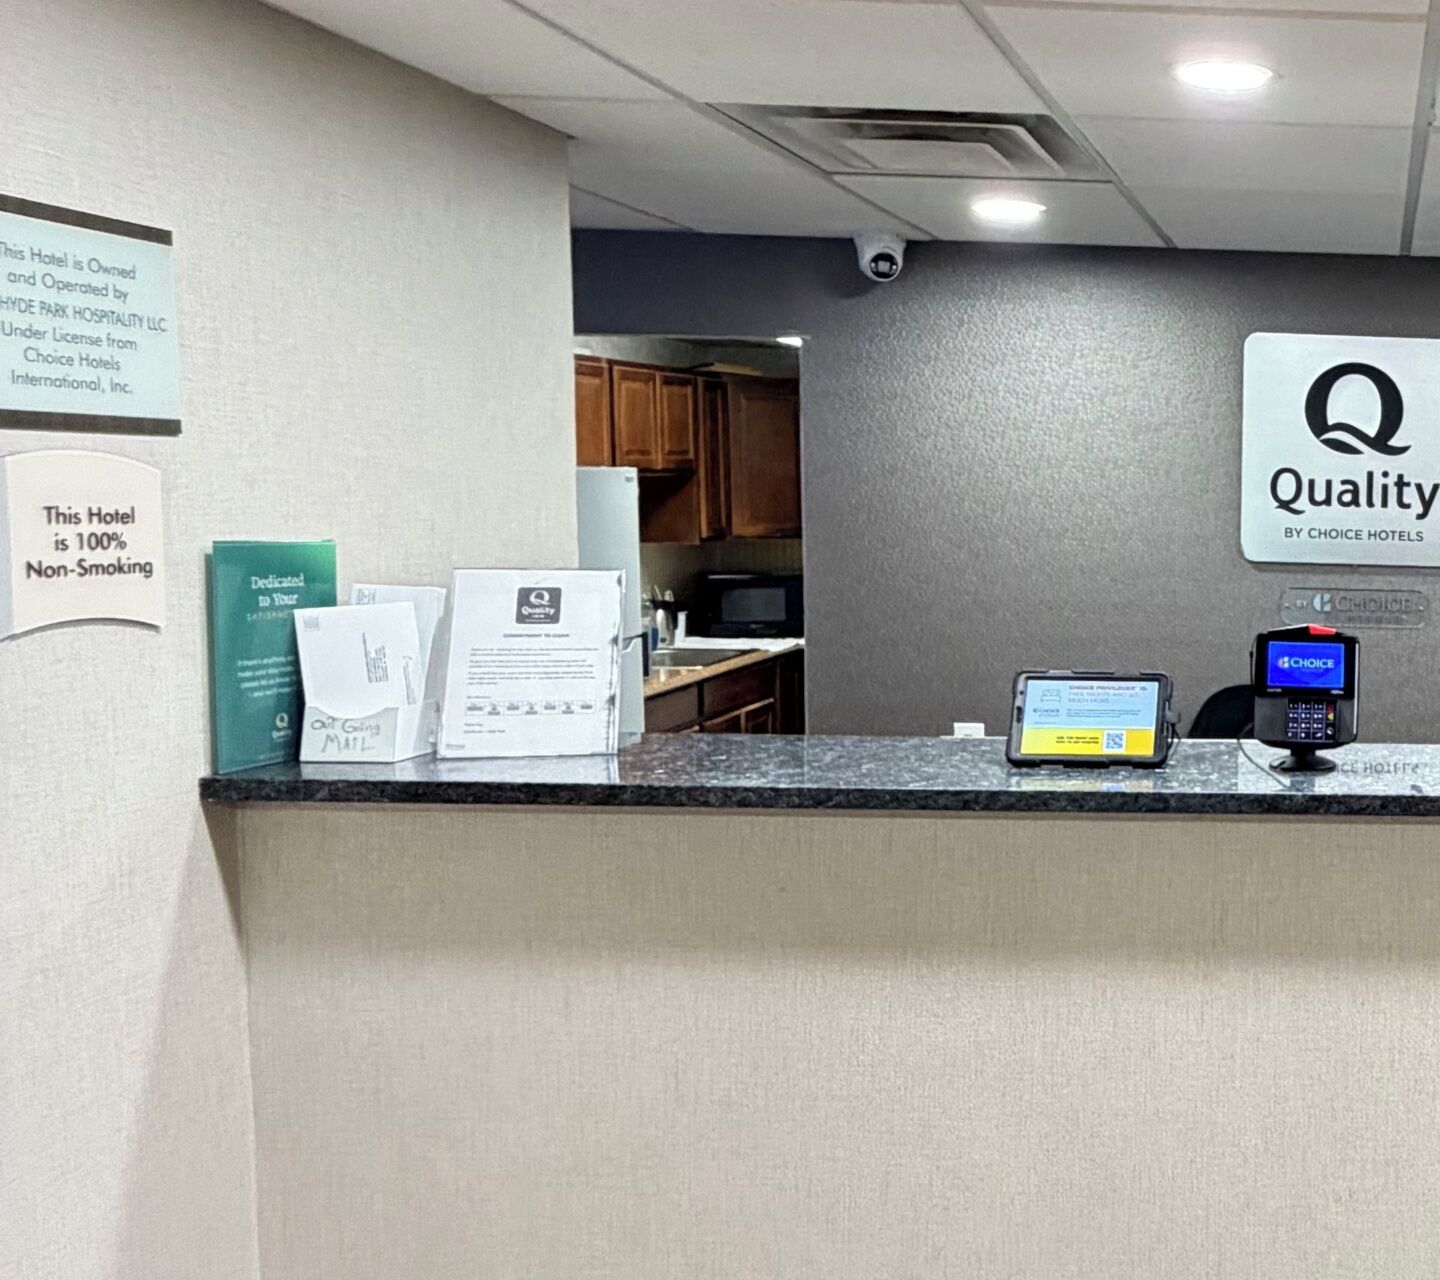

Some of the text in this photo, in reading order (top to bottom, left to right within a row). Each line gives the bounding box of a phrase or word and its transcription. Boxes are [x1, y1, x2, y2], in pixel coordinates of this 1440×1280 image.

[30, 246, 68, 268] Hotel
[73, 255, 84, 271] is
[88, 258, 136, 280] Owned
[7, 271, 129, 304] and Operated by
[39, 300, 69, 319] PARK
[72, 305, 144, 329] HOSPITALITY
[147, 317, 168, 332] LLC
[1, 322, 138, 351] Under License from
[23, 346, 121, 370] Choice Hotels
[11, 369, 134, 394] International, Inc.
[42, 505, 136, 525] This Hotel
[54, 532, 128, 551] is 100%
[1284, 527, 1424, 542] BY CHOICE HOTELS
[25, 556, 154, 579] Non-Smoking
[251, 573, 305, 588] Dedicated
[258, 592, 299, 607] to Your
[521, 606, 555, 616] Quality
[1290, 657, 1335, 669] CHOICE
